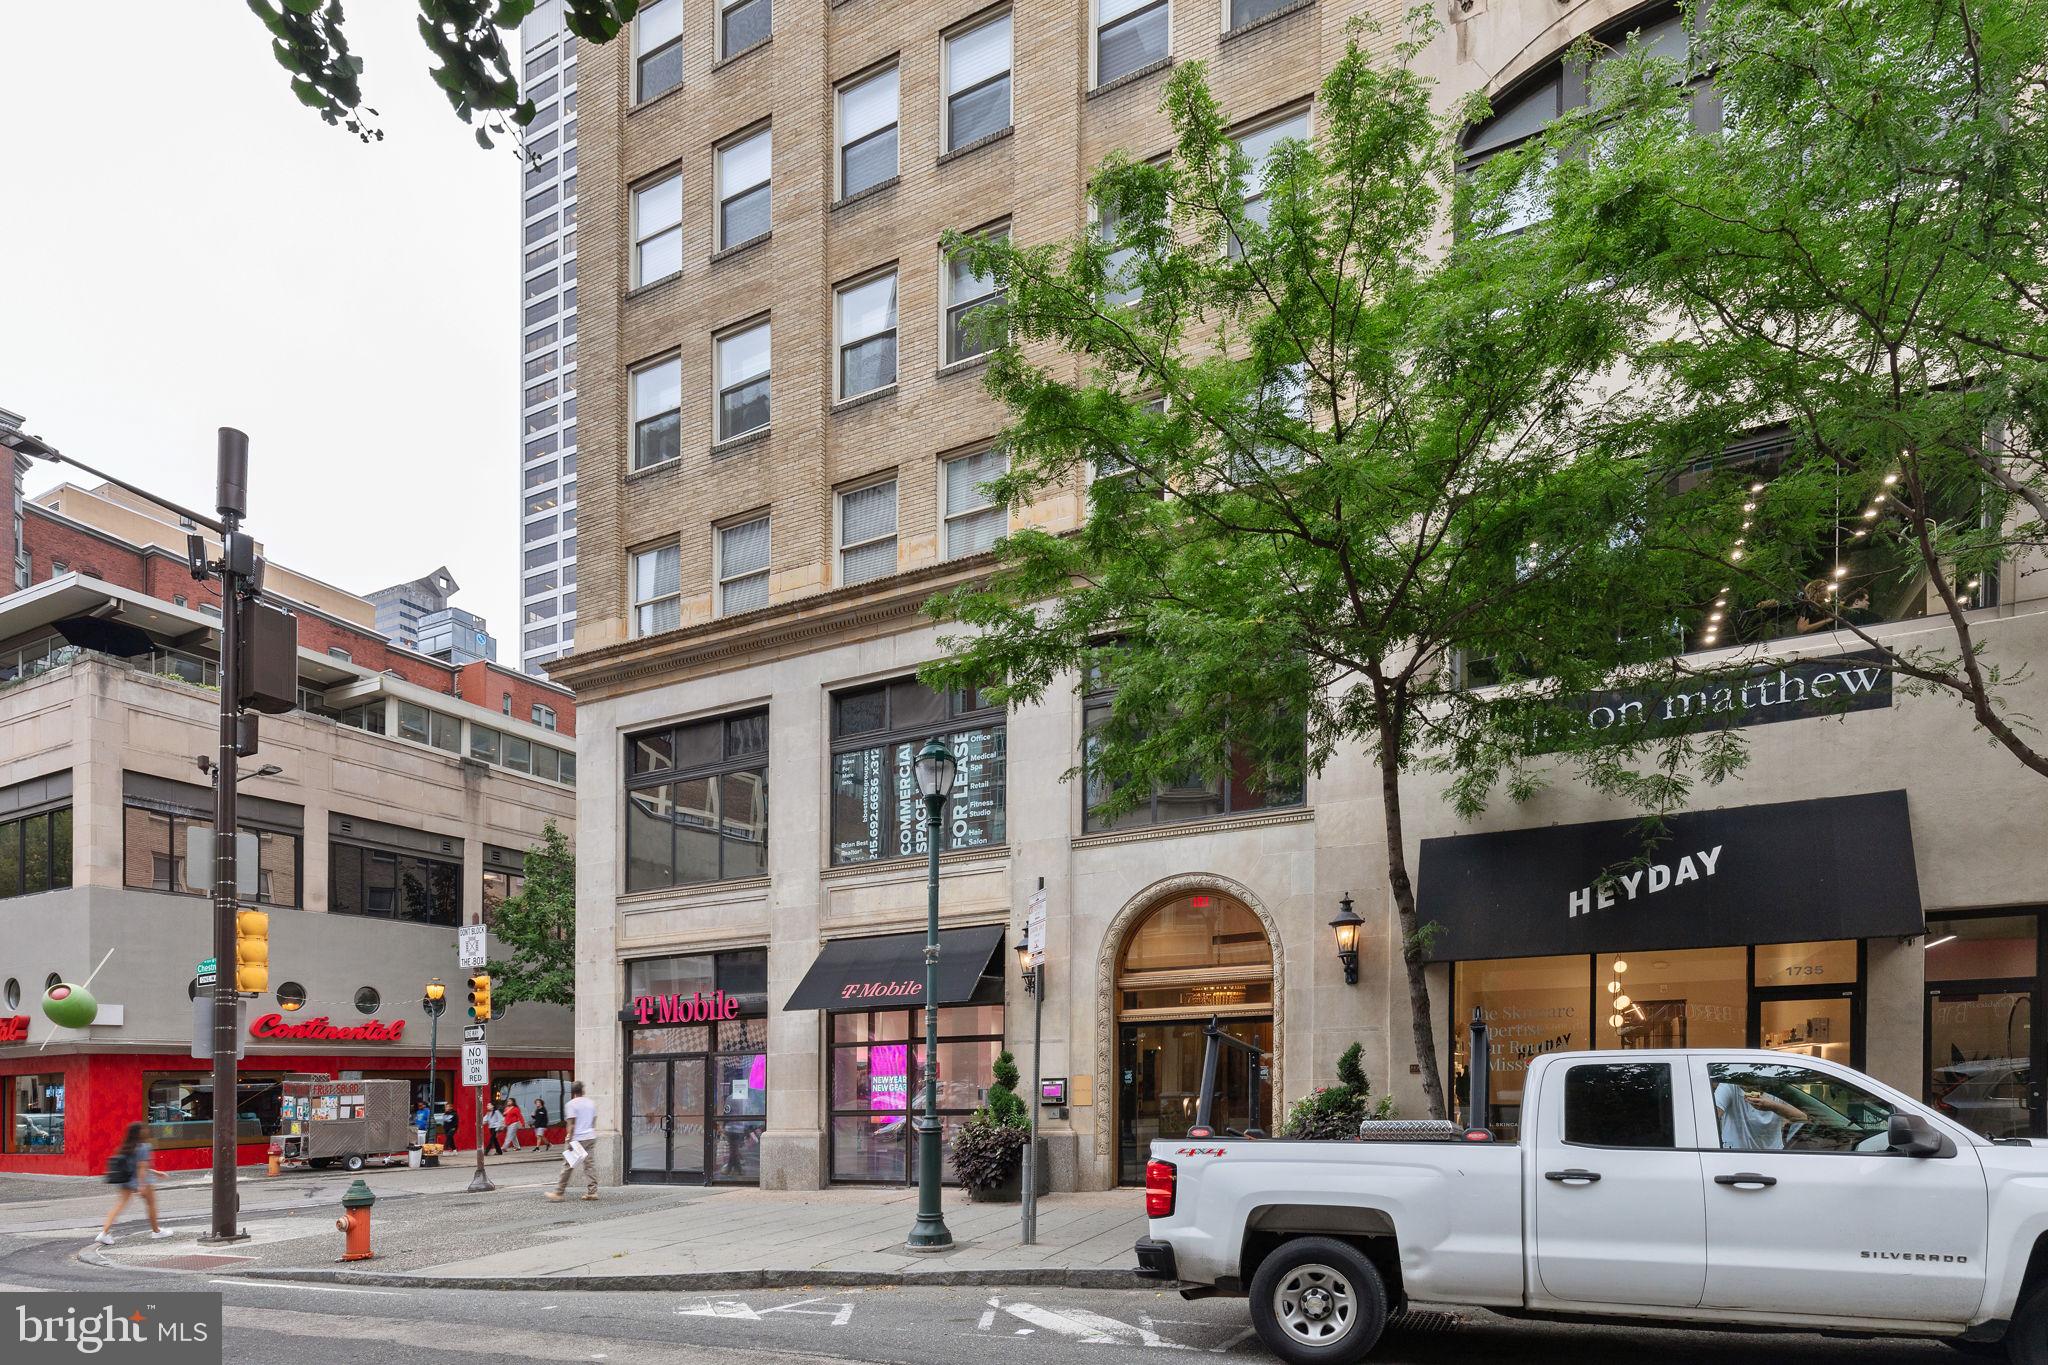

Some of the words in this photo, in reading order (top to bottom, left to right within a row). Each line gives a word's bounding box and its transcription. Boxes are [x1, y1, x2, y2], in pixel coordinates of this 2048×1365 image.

[1662, 667, 1881, 720] matthew
[970, 734, 991, 742] Office
[970, 751, 997, 761] Medical
[953, 731, 969, 799] LEASE
[970, 781, 989, 789] Retail
[970, 800, 993, 808] Fitness
[869, 777, 879, 860] 215.692.6636
[969, 809, 991, 818] Studio
[952, 805, 968, 848] FOR
[1569, 845, 1722, 918] HEYDAY
[471, 926, 484, 935] BLOCK
[461, 958, 471, 966] THE
[472, 956, 484, 965] BOX
[1785, 965, 1824, 976] 1735
[249, 1013, 406, 1041] Continental
[1488, 1022, 1545, 1039] pertise
[468, 1047, 481, 1057] NO
[466, 1058, 484, 1066] TURN
[1489, 1058, 1529, 1072] Miss
[469, 1074, 482, 1082] RED
[872, 1075, 889, 1084] NEW
[888, 1075, 907, 1083] YEAR
[313, 1084, 333, 1095] FRUIT
[336, 1083, 359, 1094] SALAD
[872, 1084, 889, 1092] NEW
[1860, 1250, 1968, 1264] SILVERADO
